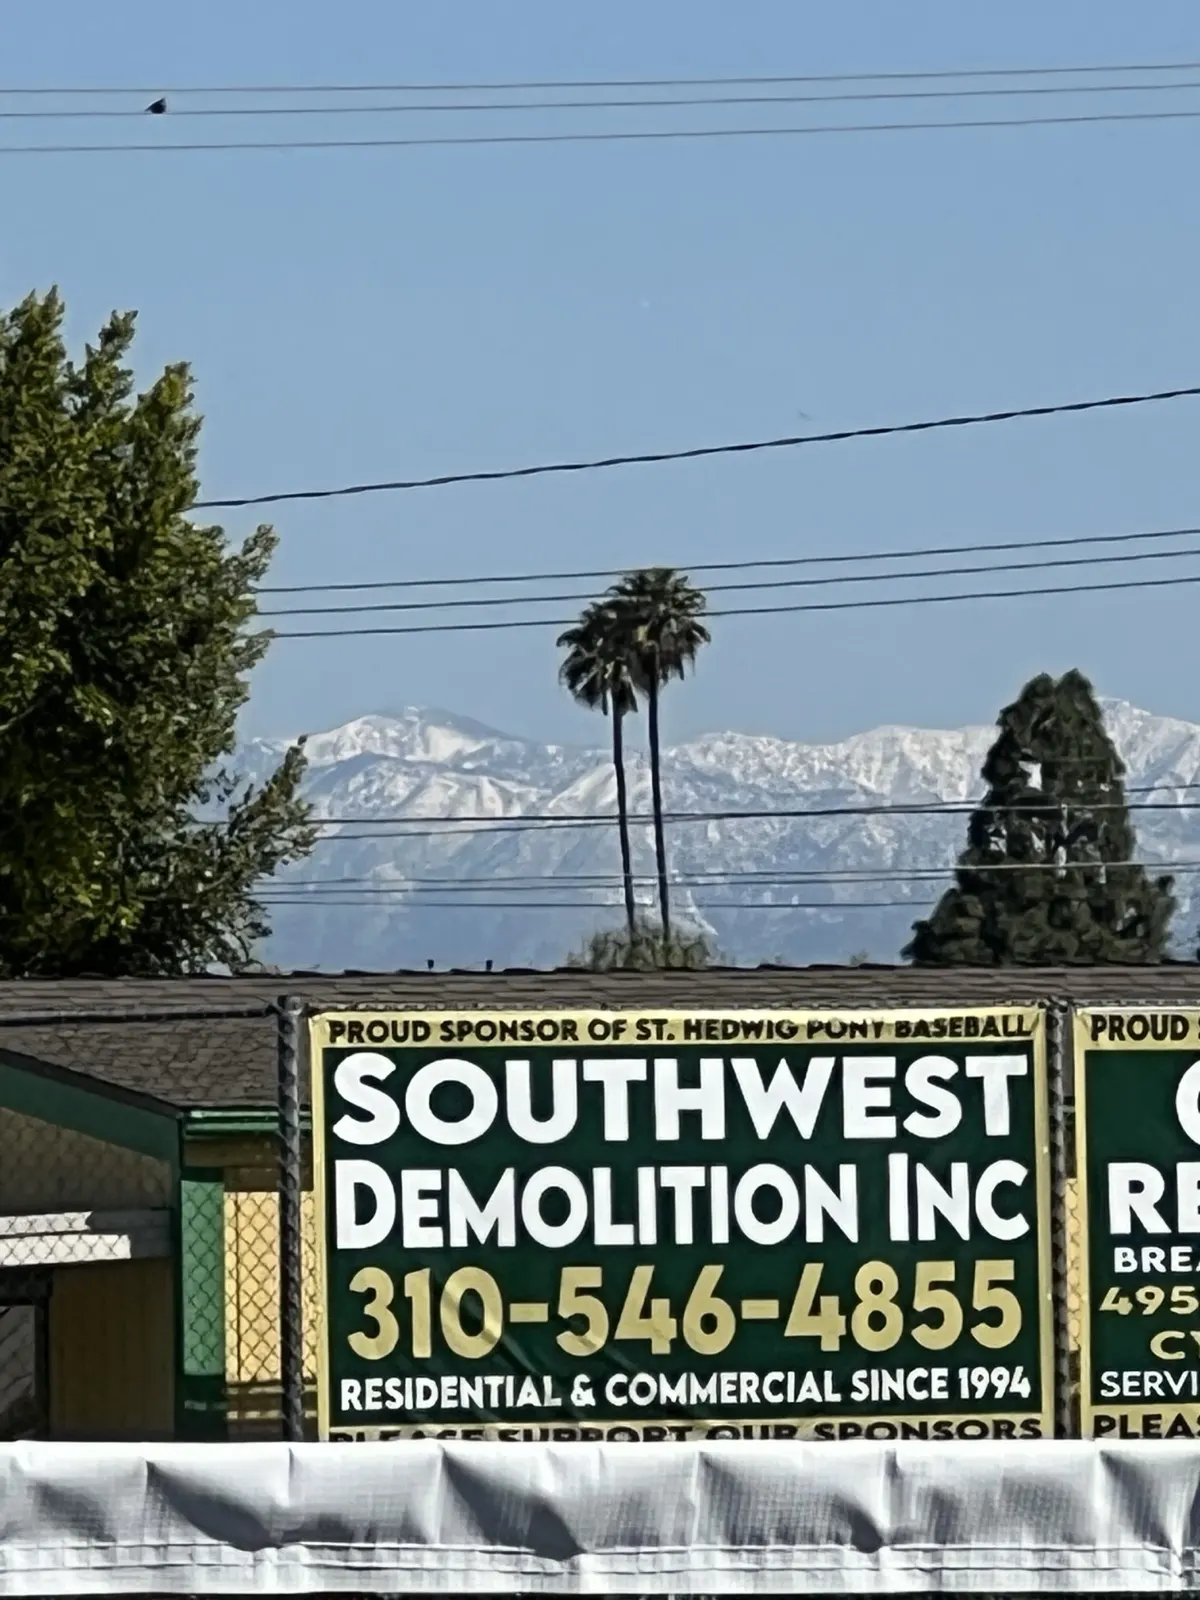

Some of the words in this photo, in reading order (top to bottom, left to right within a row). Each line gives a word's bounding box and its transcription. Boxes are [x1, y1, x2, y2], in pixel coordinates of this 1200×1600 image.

[328, 1020, 430, 1043] PROUD
[439, 1019, 579, 1042] SPONSOR
[587, 1019, 627, 1041] OF
[635, 1018, 676, 1041] ST.
[683, 1018, 798, 1041] HEDWIG
[806, 1018, 884, 1039] PONY
[895, 1014, 1033, 1038] BASEBALL
[1091, 1014, 1190, 1041] PROUD
[332, 1052, 1028, 1145] SOUTHWEST
[334, 1159, 859, 1249] DEMOLITION
[1113, 1245, 1200, 1273] BRE
[347, 1259, 1022, 1360] 310-546-4855
[1099, 1285, 1199, 1315] 495
[340, 1375, 561, 1411] RESIDENTIAL
[570, 1373, 596, 1406] &
[605, 1369, 842, 1406] COMMERCIAL
[850, 1367, 949, 1402] SINCE
[958, 1366, 1031, 1400] 1994
[1100, 1370, 1198, 1397] SERVI
[813, 1418, 1043, 1441] SPONSORS
[1093, 1412, 1200, 1440] PLEA
